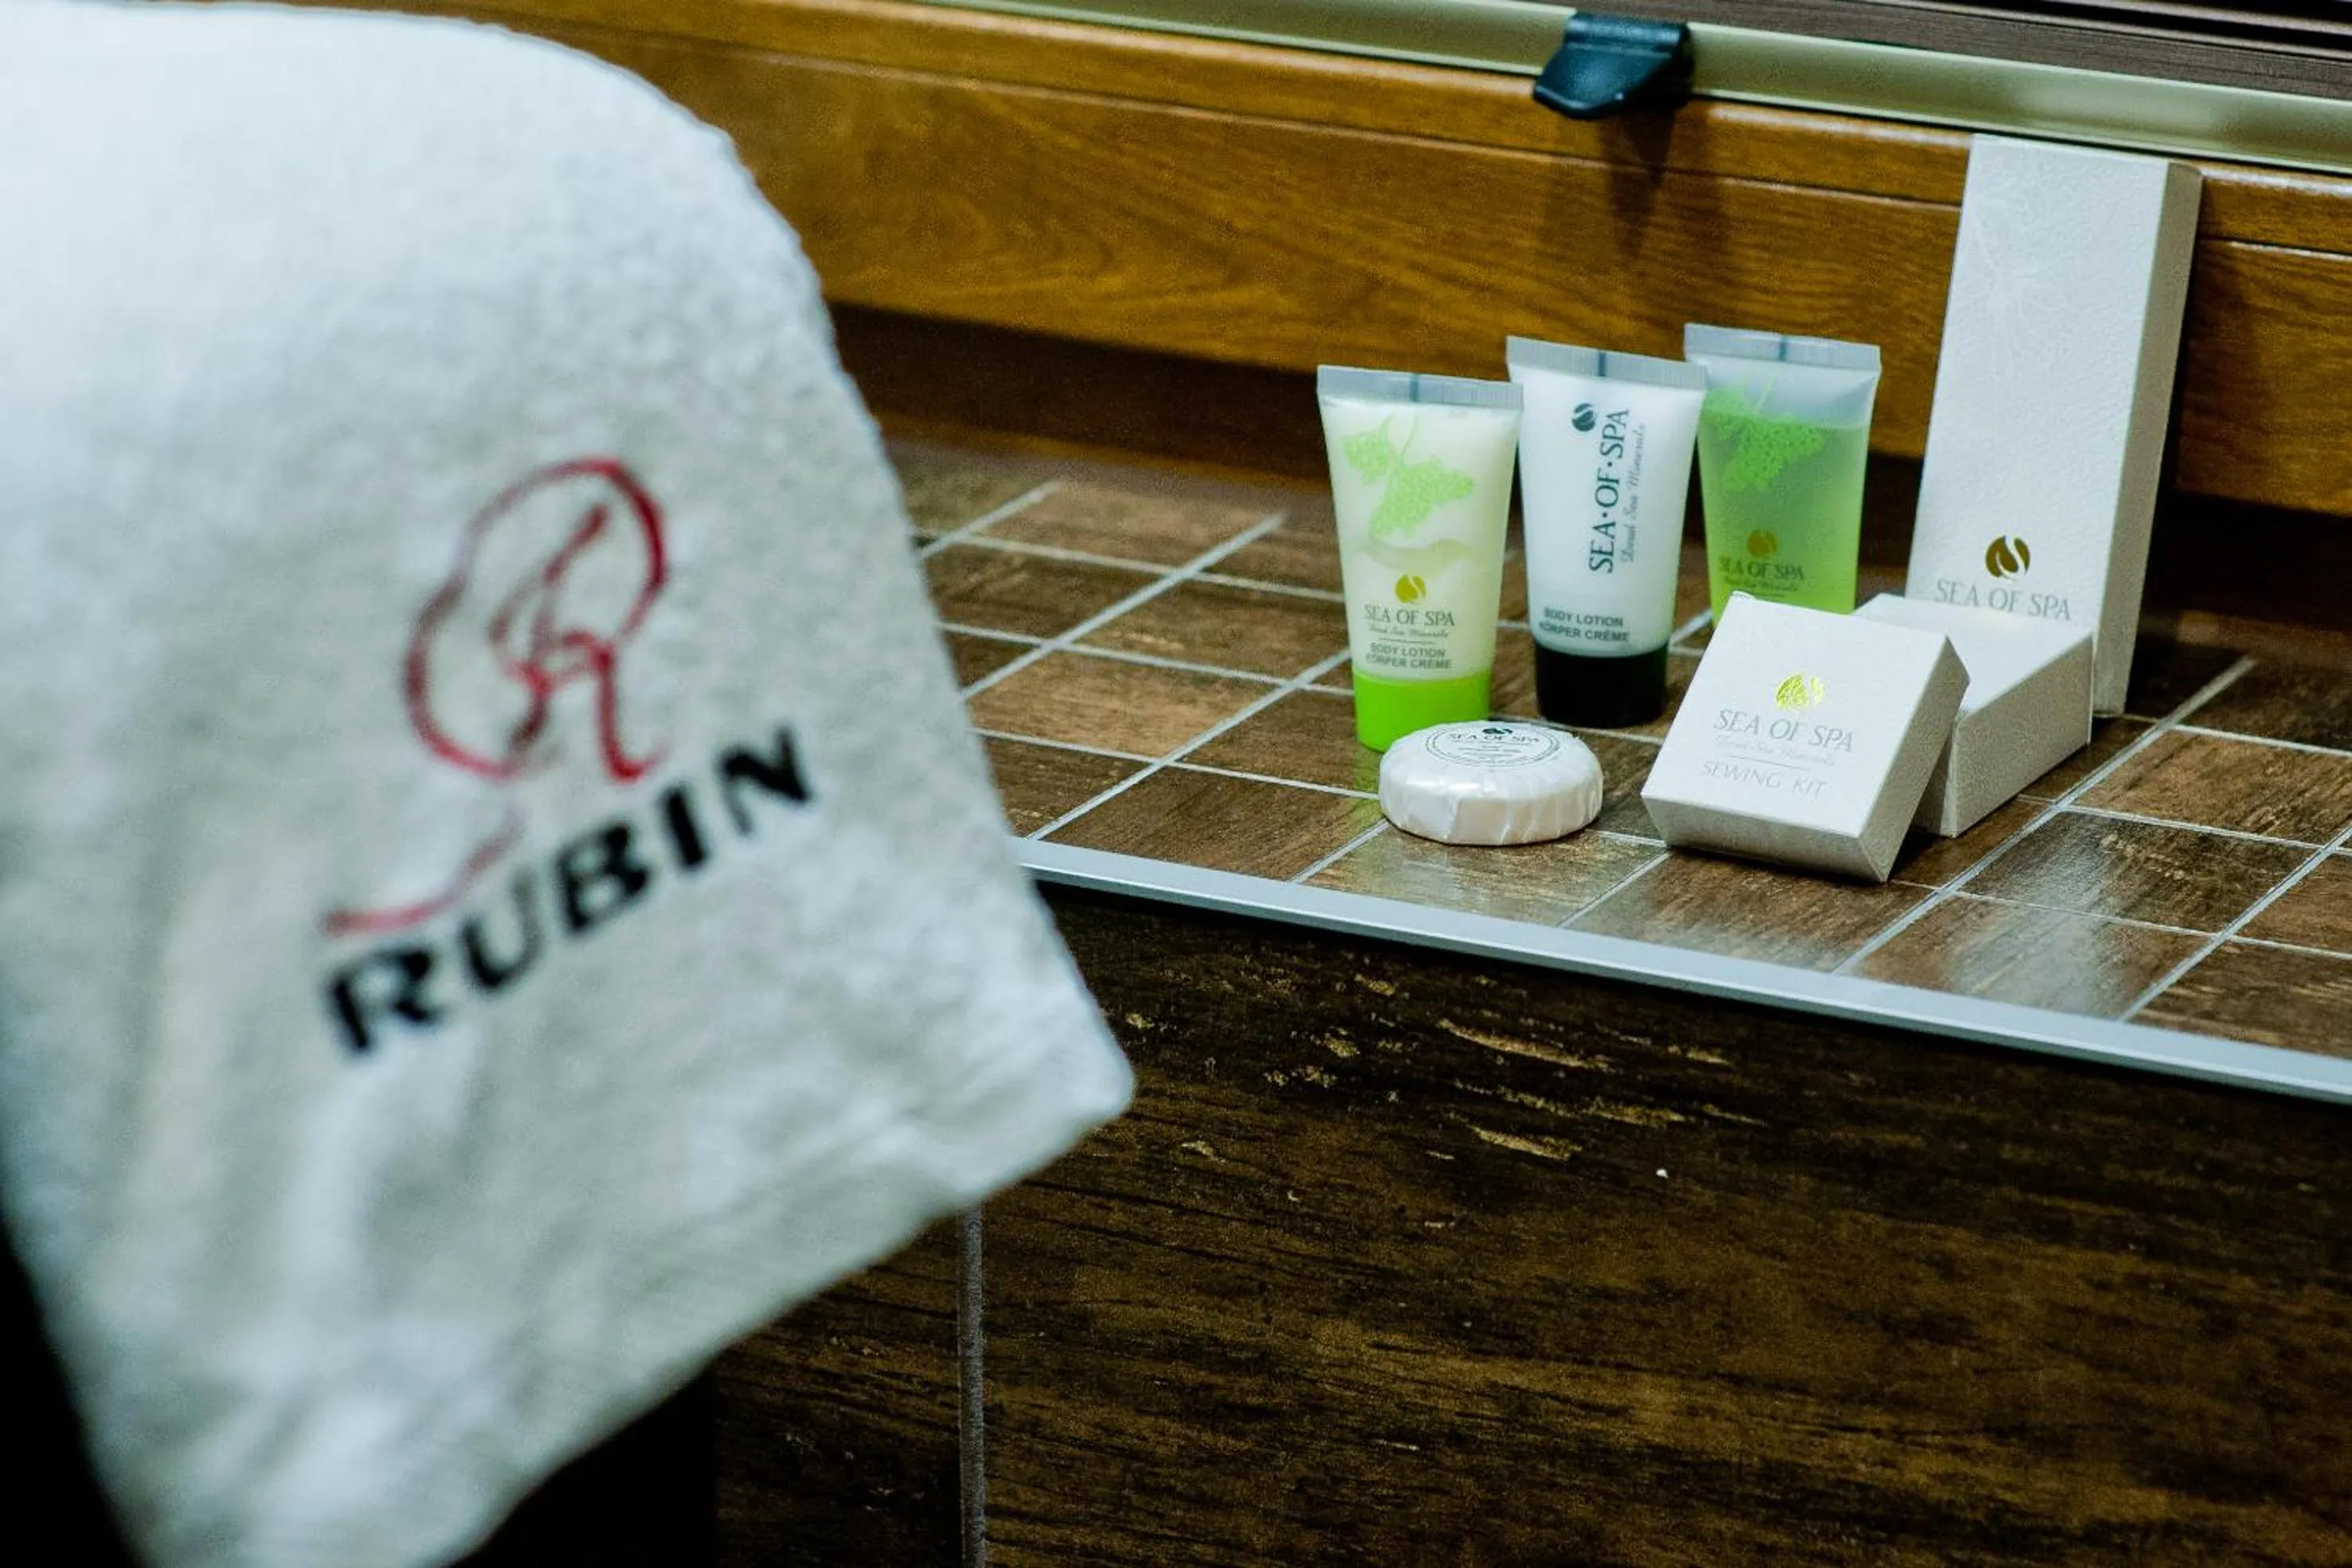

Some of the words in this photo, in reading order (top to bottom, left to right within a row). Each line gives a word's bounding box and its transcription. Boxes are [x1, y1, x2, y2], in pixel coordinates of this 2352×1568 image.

[1747, 561, 1770, 577] OF
[1775, 564, 1806, 580] SPA
[1364, 604, 1391, 623] SEA
[1396, 608, 1419, 625] OF
[1424, 611, 1455, 627] SPA
[1935, 579, 1980, 608] SEA
[1989, 588, 2023, 613] OF
[2029, 593, 2071, 621] SPA
[1544, 607, 1572, 622] BODY
[1576, 614, 1623, 627] LOTION
[1370, 643, 1399, 655] BODY
[1402, 647, 1446, 658] LOTION
[1714, 709, 1760, 736] SEA
[1769, 718, 1808, 741] OF
[1808, 725, 1853, 752] SPA
[1700, 761, 1784, 788] SEWING
[1793, 777, 1827, 800] KIT
[325, 725, 812, 1053] RUBIN
